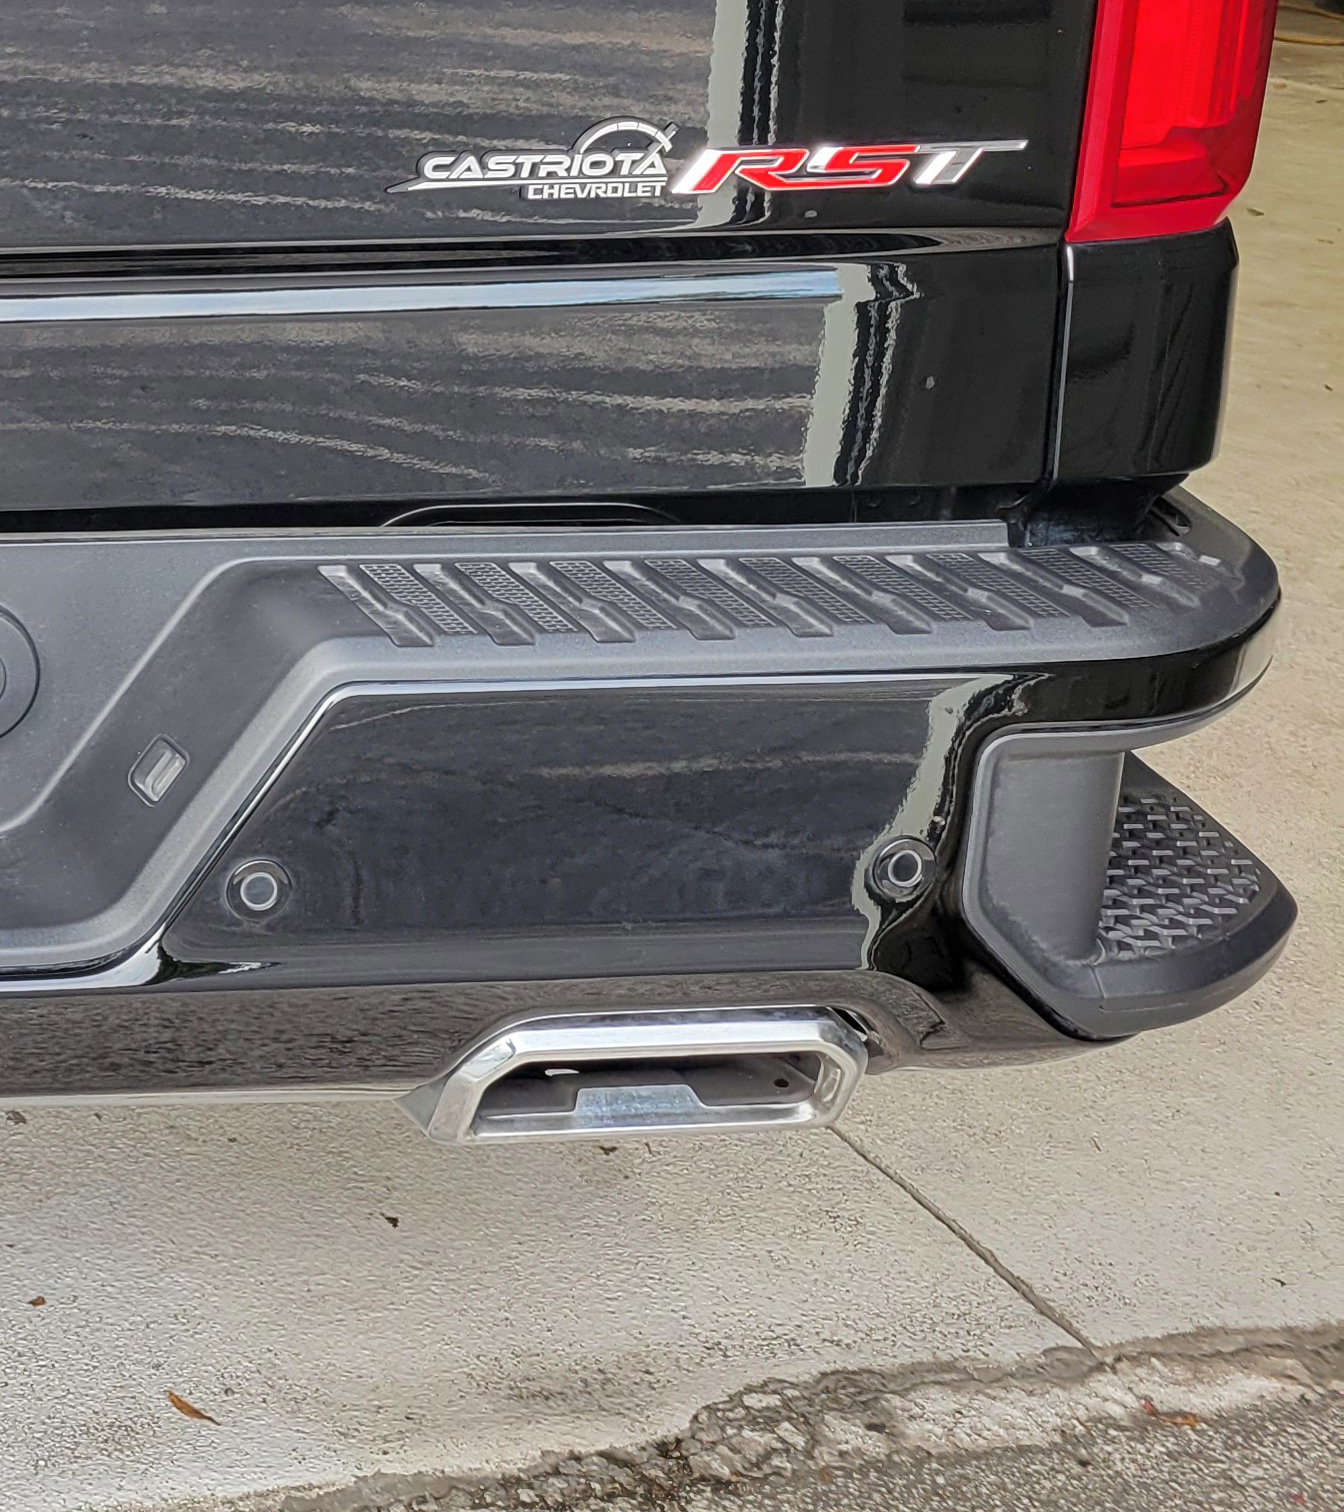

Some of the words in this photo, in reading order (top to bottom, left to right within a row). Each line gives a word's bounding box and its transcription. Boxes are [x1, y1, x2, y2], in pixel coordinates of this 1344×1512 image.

[420, 148, 668, 181] CASTRIOTA
[670, 139, 1029, 196] RST
[525, 179, 668, 201] CHEVROLET
